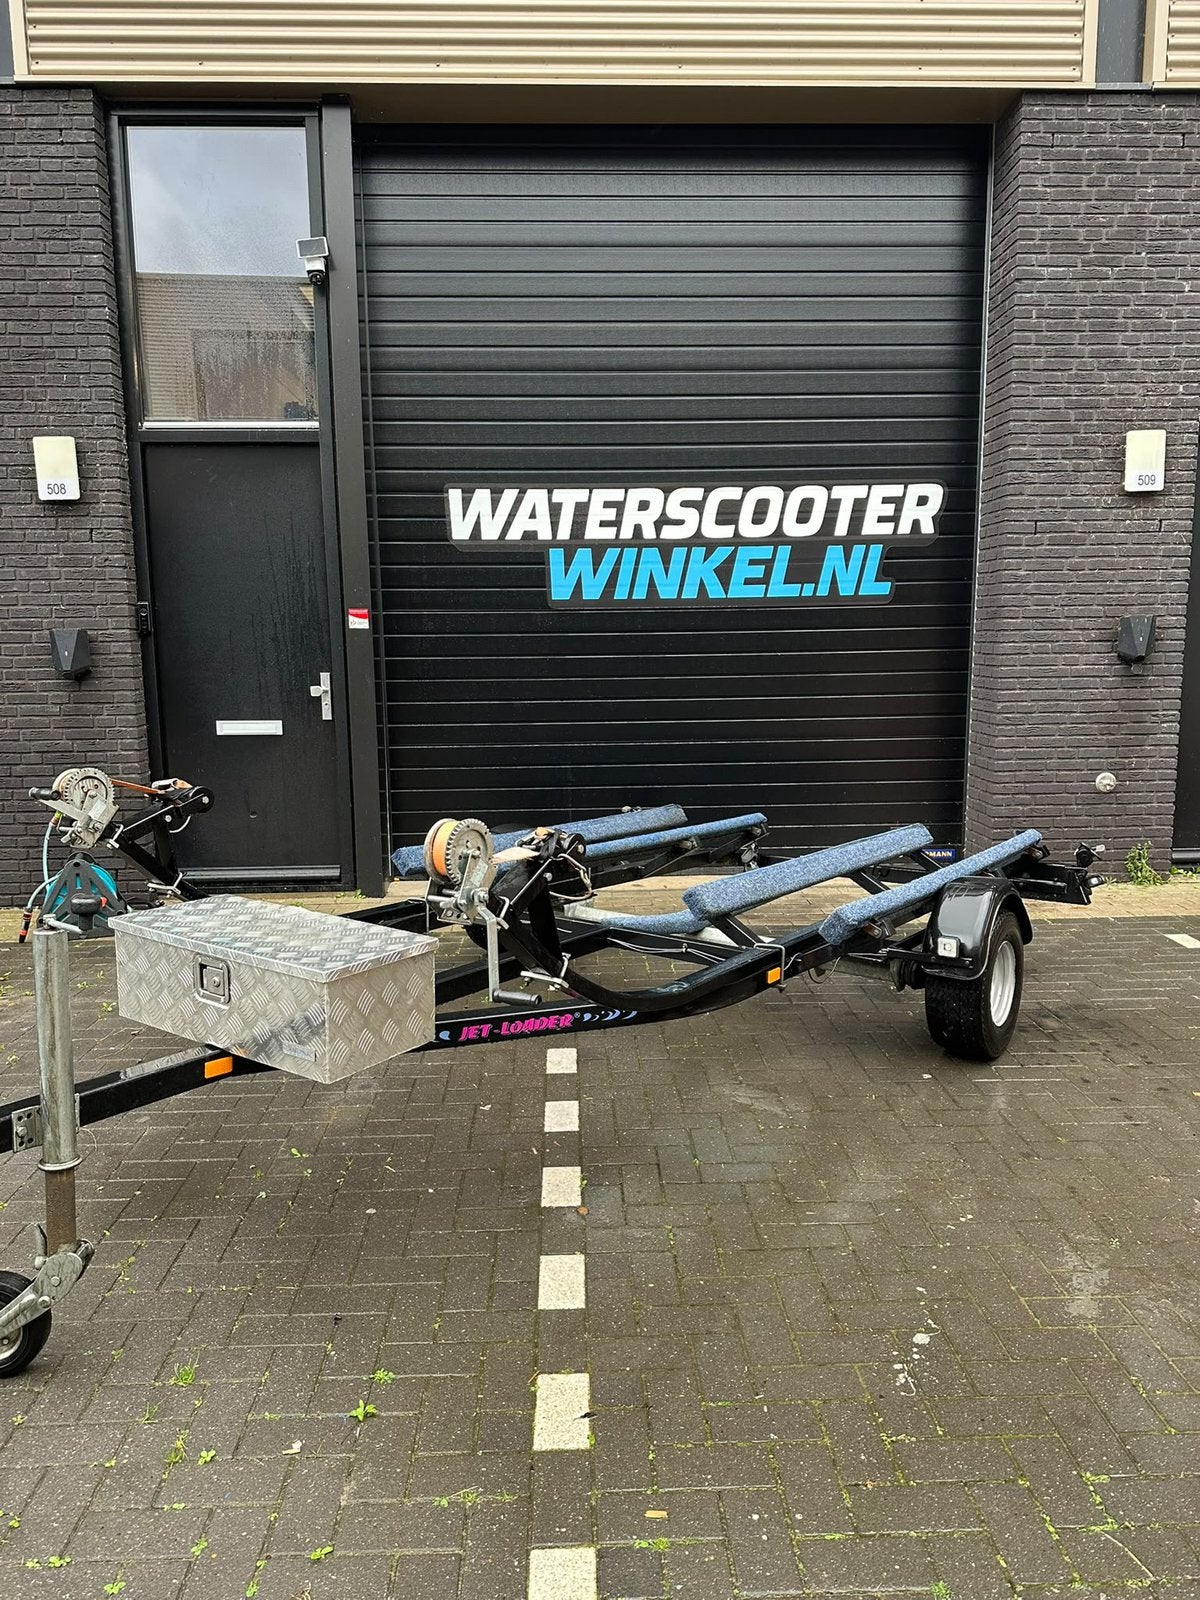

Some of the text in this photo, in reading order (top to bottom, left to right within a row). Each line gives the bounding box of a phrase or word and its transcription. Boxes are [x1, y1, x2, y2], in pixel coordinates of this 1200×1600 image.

[46, 482, 67, 495] 508
[1137, 474, 1156, 486] 509
[448, 483, 944, 541] WATERSCOOTER
[548, 544, 892, 600] WINKEL.NL
